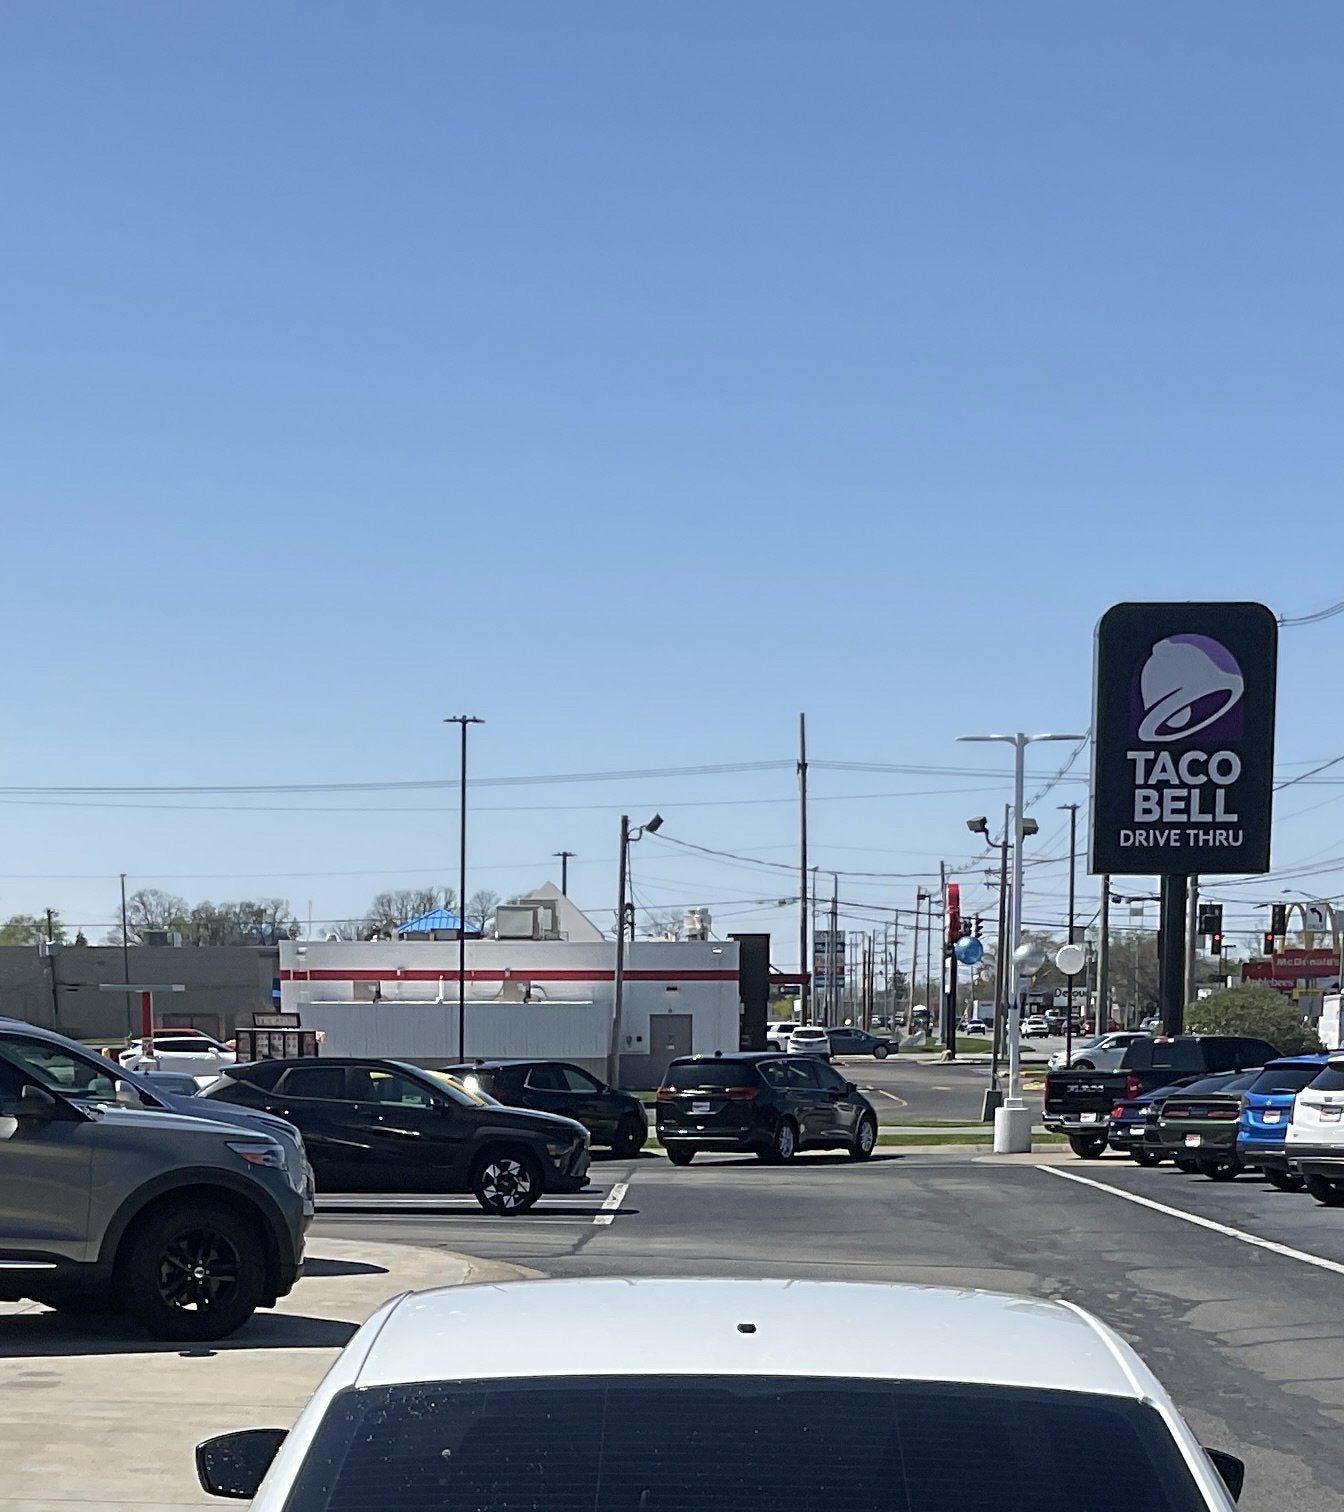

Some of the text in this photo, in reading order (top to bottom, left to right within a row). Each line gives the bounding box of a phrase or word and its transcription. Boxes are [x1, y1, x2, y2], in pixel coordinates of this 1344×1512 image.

[1127, 751, 1241, 785] TACO
[1134, 788, 1238, 823] BELL
[1120, 830, 1243, 847] DRIVE THRU
